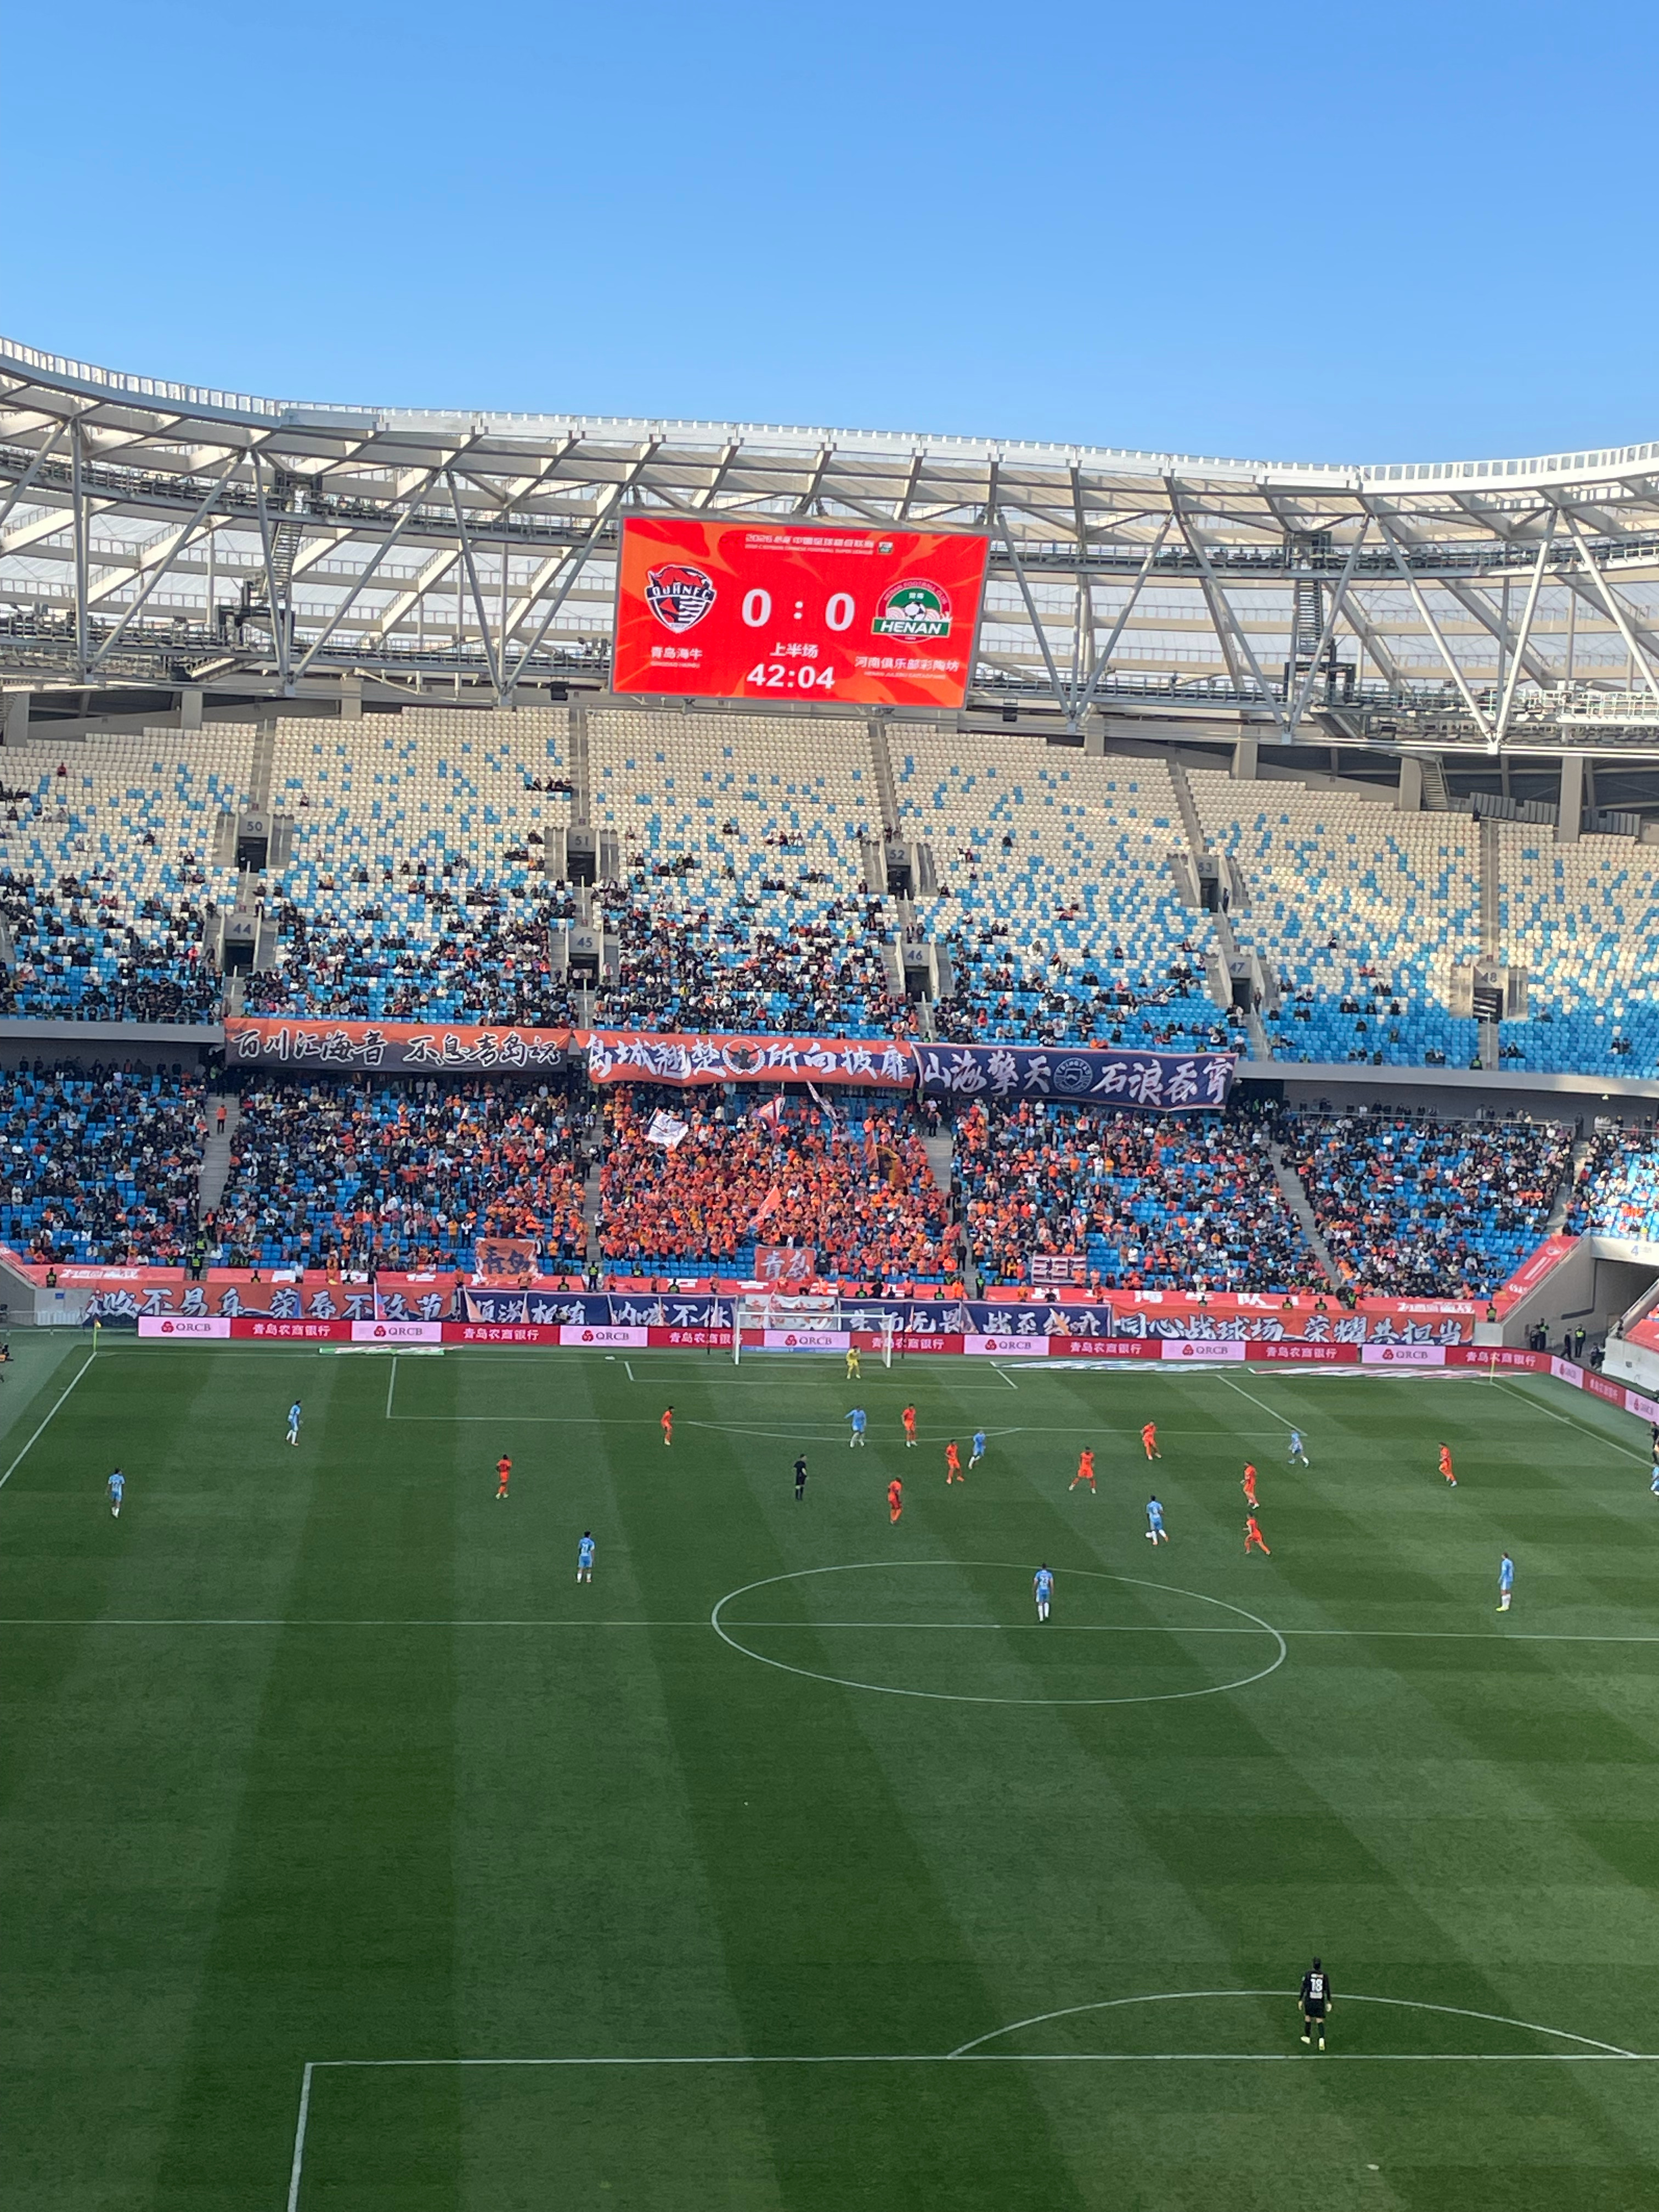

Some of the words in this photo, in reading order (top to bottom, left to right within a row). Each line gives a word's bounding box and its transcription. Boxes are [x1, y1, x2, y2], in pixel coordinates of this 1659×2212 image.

[742, 589, 772, 628] 0
[825, 592, 855, 631] 0
[880, 620, 943, 635] HENAN
[651, 646, 703, 661] 青岛海牛
[770, 642, 819, 658] 上半场
[854, 656, 960, 672] 河南俱乐部彩陶坊
[747, 663, 835, 689] 42:04
[246, 821, 263, 832] 50
[575, 836, 589, 847] 51
[889, 850, 905, 860] 52
[233, 923, 251, 933] 44
[577, 936, 593, 948] 45
[907, 950, 923, 960] 46
[1229, 962, 1245, 973] 47
[403, 1031, 561, 1066] 不息青岛魂
[767, 1042, 911, 1082] 所向披靡
[924, 1048, 1051, 1096] 山海擎天
[1630, 1245, 1639, 1256] 4
[176, 1323, 211, 1332] QRCB
[252, 1323, 331, 1338] 青岛农商银行
[388, 1327, 423, 1336] QRCB
[1303, 1314, 1462, 1346] 荣耀共担当
[463, 1327, 540, 1341] 青岛农商银行
[595, 1331, 630, 1341] QRCB
[799, 1336, 833, 1346] QRCB
[998, 1341, 1032, 1350] QRCB
[1070, 1342, 1142, 1355] 青岛农商银行
[1195, 1346, 1228, 1355] QRCB
[1266, 1346, 1338, 1359] 青岛农商银行
[1396, 1350, 1429, 1359] QRCB
[1310, 1978, 1323, 1993] 18
